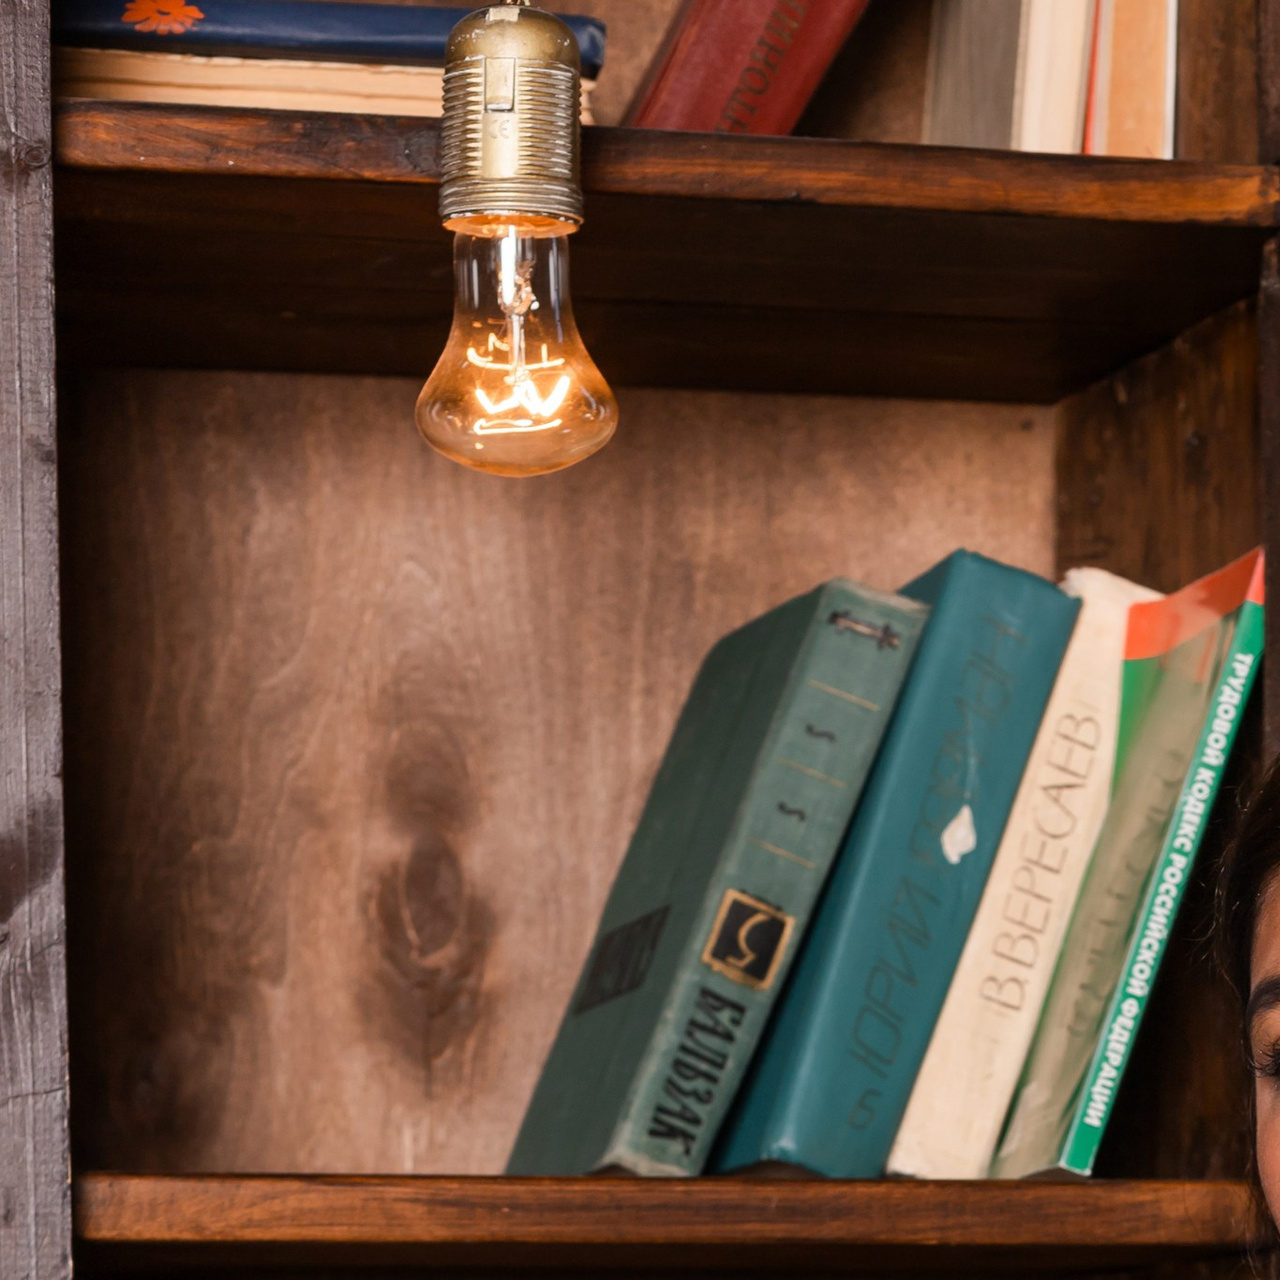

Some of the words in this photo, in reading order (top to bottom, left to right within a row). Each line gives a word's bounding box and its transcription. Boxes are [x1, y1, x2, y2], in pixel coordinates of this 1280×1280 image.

[1202, 653, 1253, 768] ТРУДОВОЙ
[1173, 765, 1216, 853] КОДЕКС
[847, 875, 943, 1079] ЮРИЙ
[1126, 848, 1188, 999] РОССИЙСКОЙ
[649, 985, 748, 1157] БАЛЬЗАК
[1083, 994, 1146, 1128] ФЕДЕРАЦИИ
